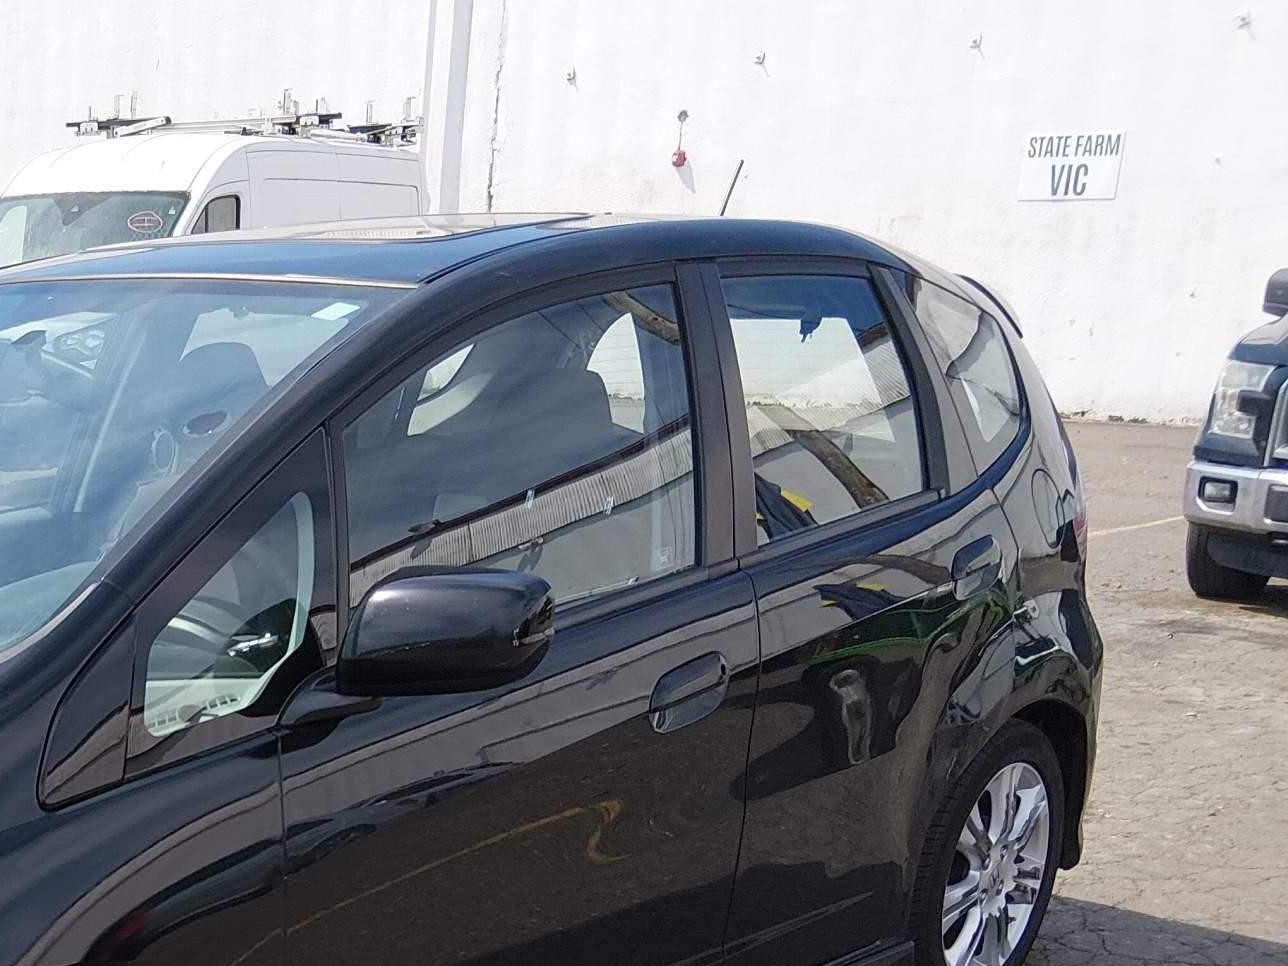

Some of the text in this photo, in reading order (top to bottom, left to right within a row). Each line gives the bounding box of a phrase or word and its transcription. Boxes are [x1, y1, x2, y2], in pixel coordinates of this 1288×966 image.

[1028, 133, 1122, 158] STATE FARM
[1050, 163, 1089, 196] VIC
